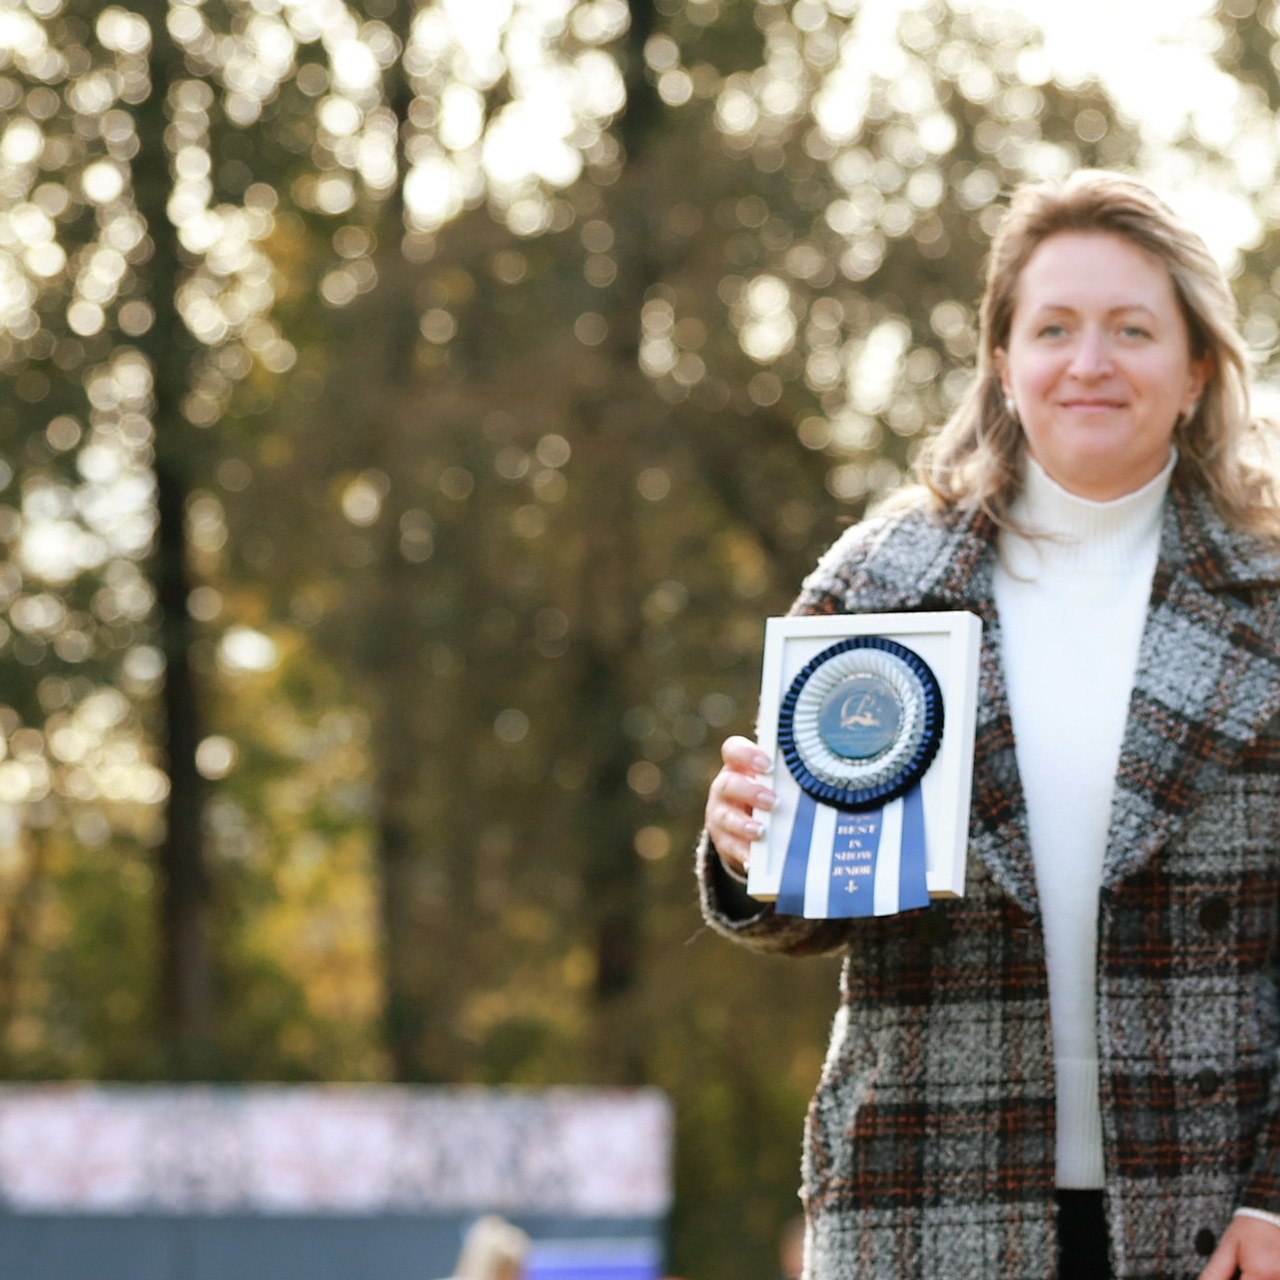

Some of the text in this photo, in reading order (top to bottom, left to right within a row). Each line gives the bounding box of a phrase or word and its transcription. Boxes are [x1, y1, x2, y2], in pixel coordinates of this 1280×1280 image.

[838, 825, 877, 835] BEST
[848, 839, 862, 850] IN
[834, 851, 873, 861] SHOW
